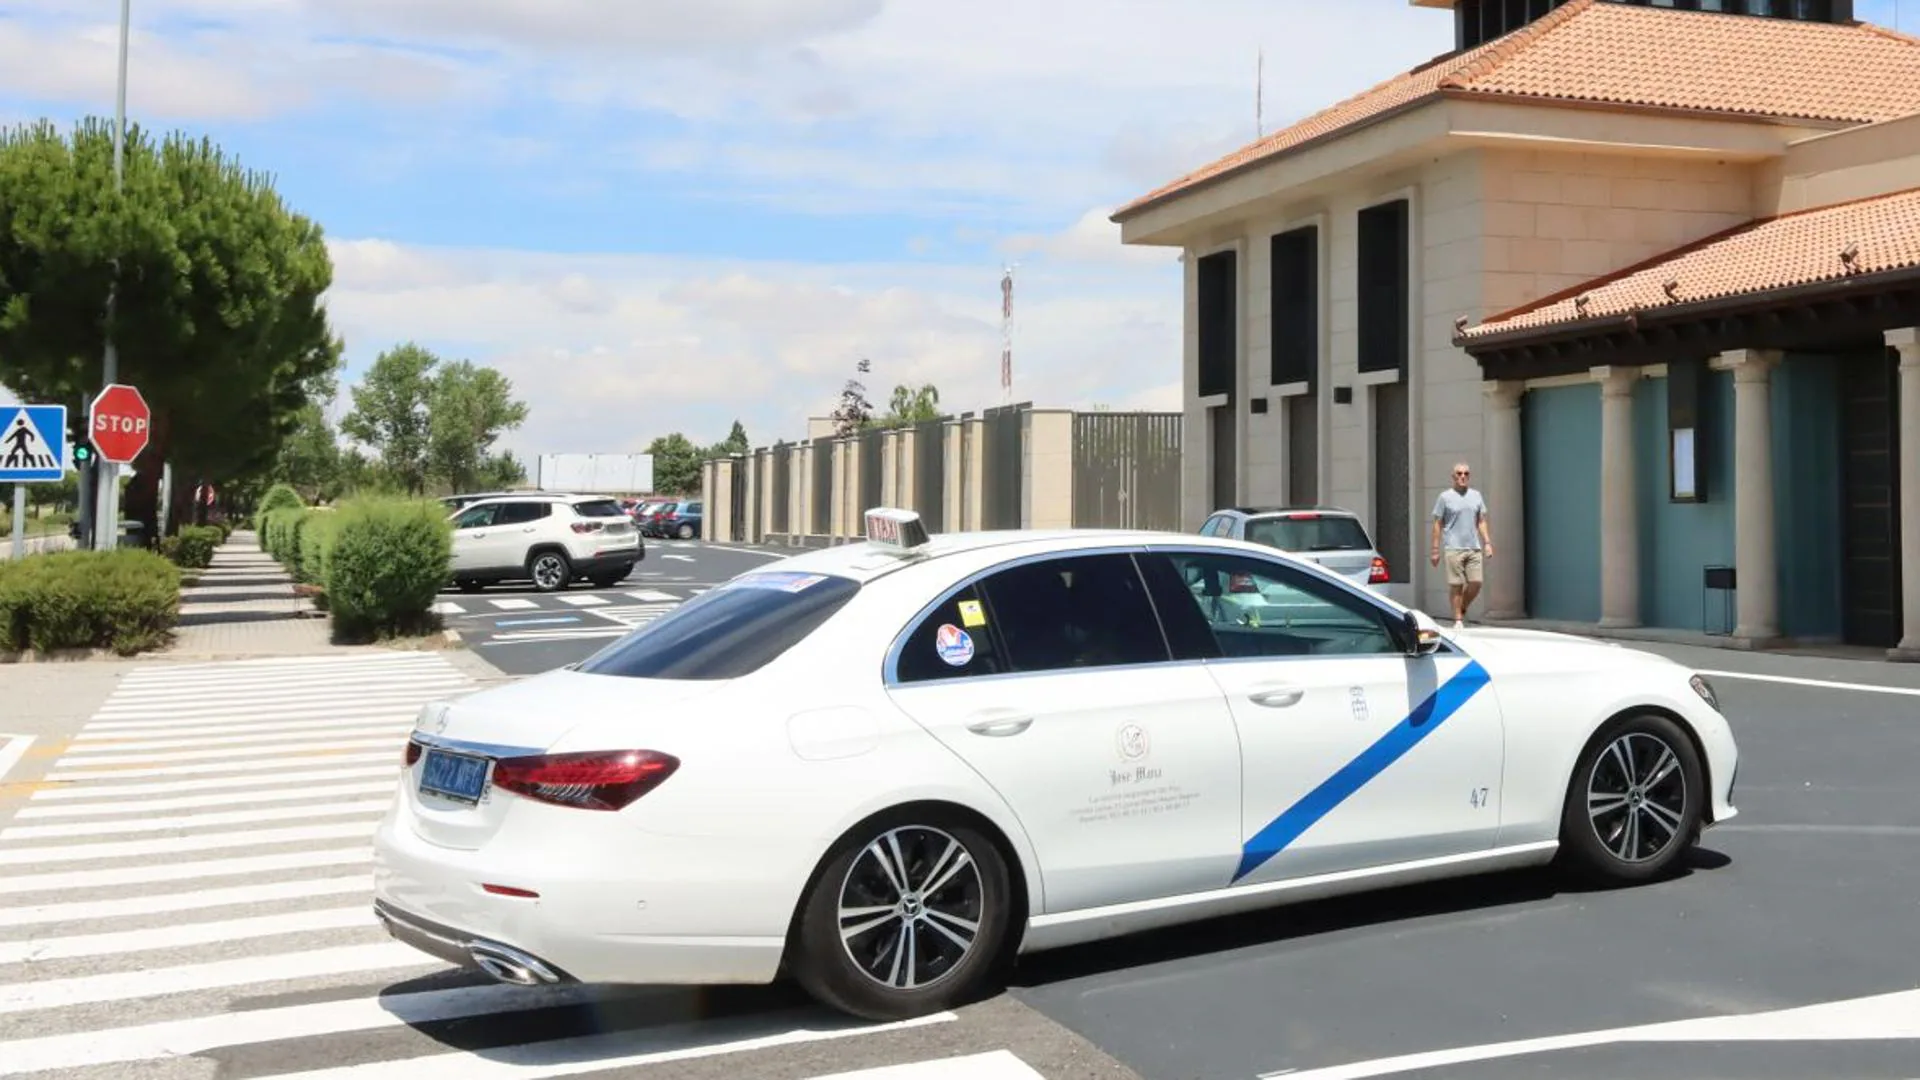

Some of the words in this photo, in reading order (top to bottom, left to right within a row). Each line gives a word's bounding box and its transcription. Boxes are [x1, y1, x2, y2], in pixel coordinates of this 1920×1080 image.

[96, 413, 146, 434] STOP
[871, 516, 897, 539] TAXI
[1470, 787, 1489, 809] 47
